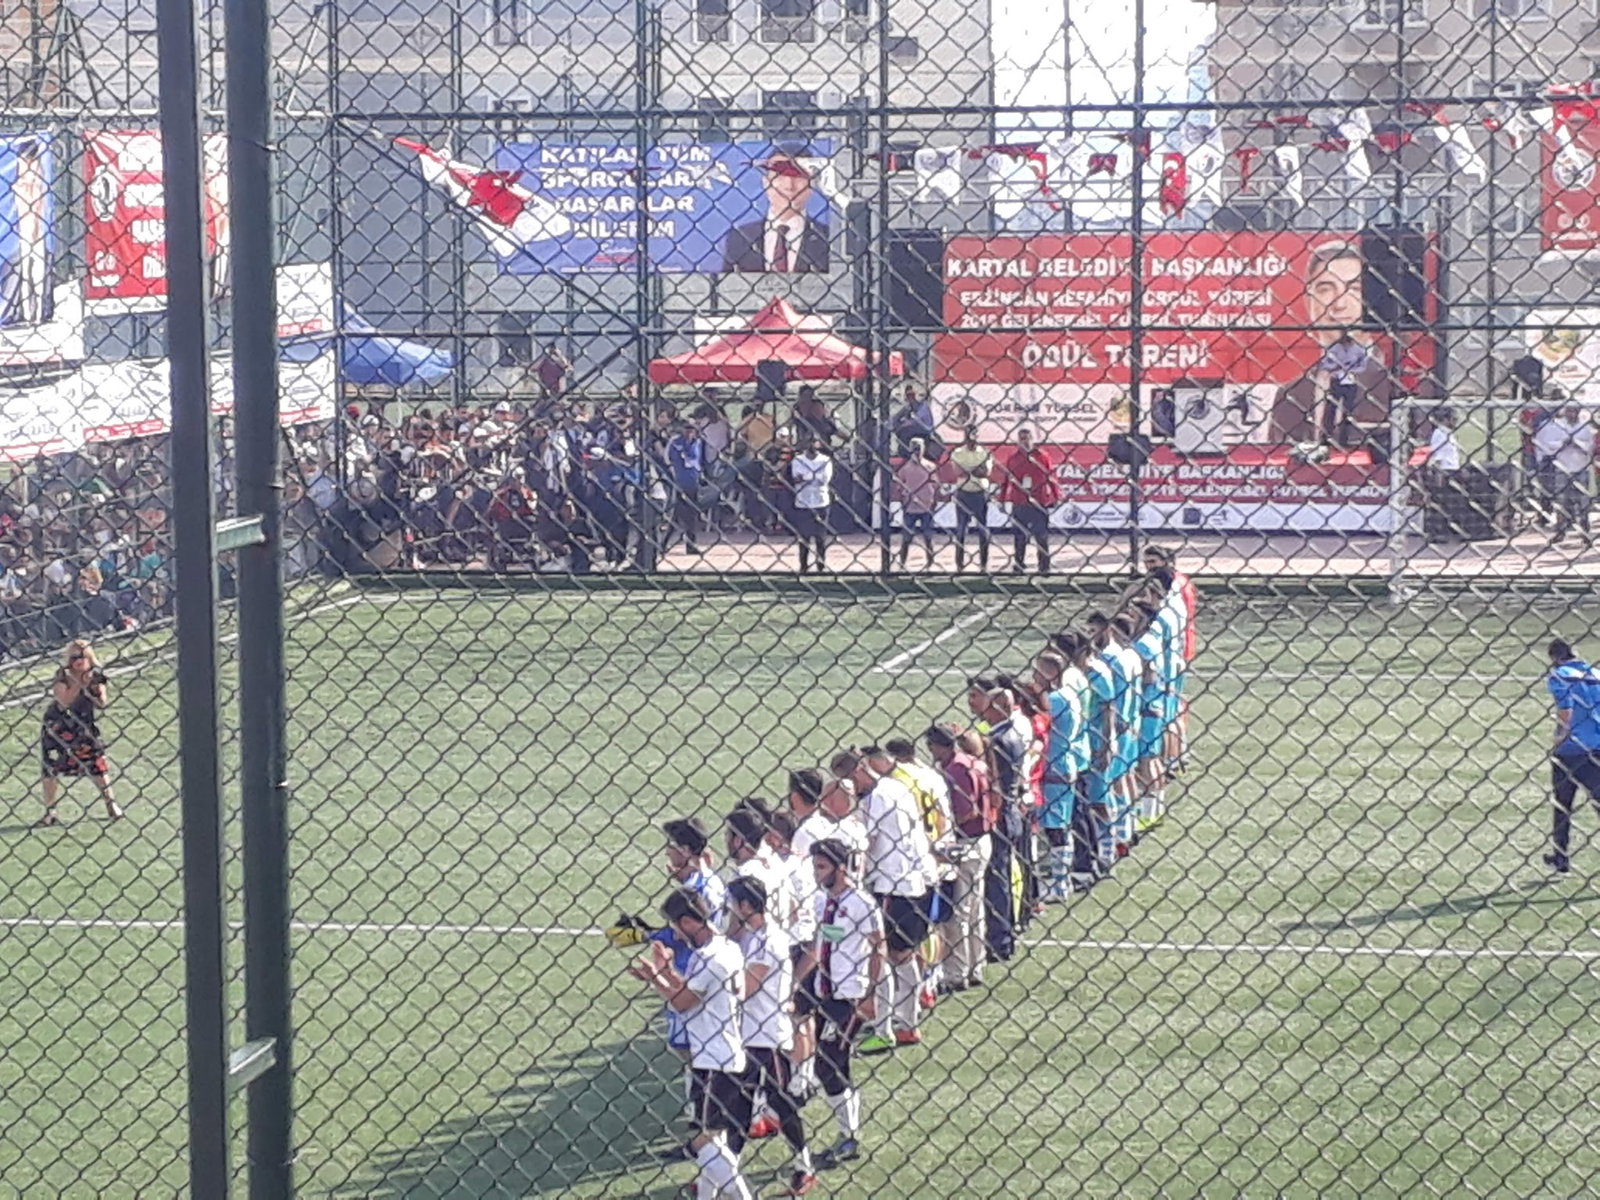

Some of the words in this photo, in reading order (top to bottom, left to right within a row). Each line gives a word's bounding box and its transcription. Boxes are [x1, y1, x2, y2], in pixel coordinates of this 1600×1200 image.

[556, 195, 695, 215] BAŞARLAR
[947, 257, 1033, 278] KARTAL
[1038, 256, 1145, 278] BELEDİY
[1021, 340, 1098, 369] ÖDÜL
